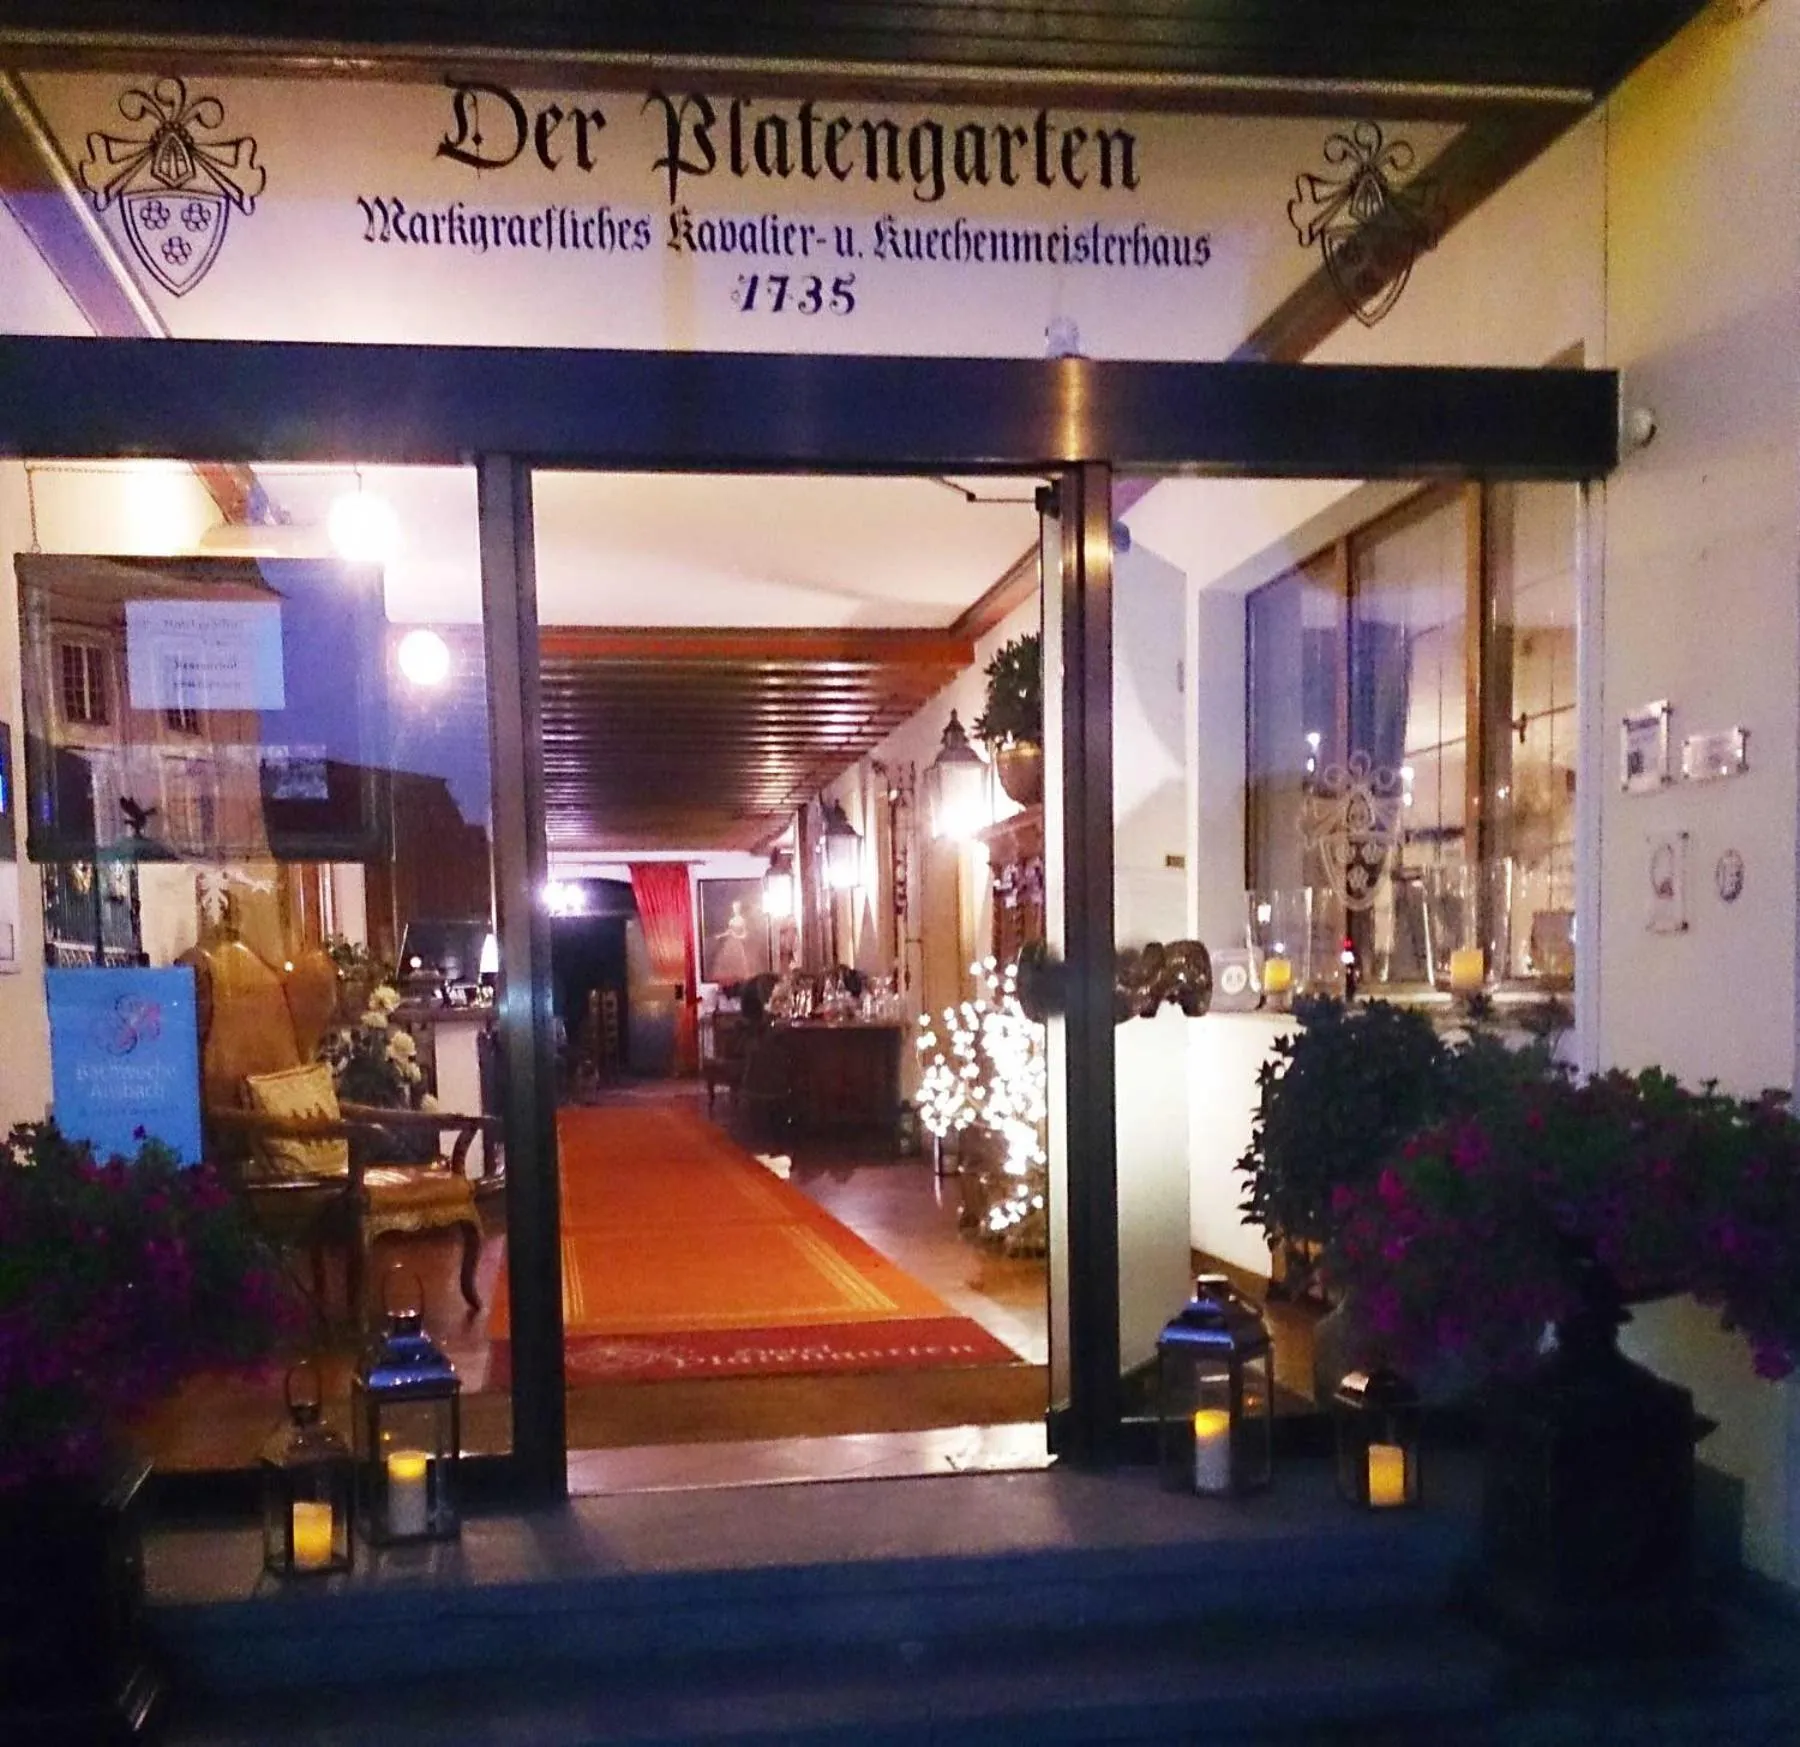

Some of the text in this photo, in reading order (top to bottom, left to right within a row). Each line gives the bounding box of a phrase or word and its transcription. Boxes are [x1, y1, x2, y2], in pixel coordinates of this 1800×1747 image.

[437, 74, 1141, 204] Der Platengarten
[873, 213, 1212, 267] Kuechenmeisterhaus
[734, 272, 856, 315] 1735
